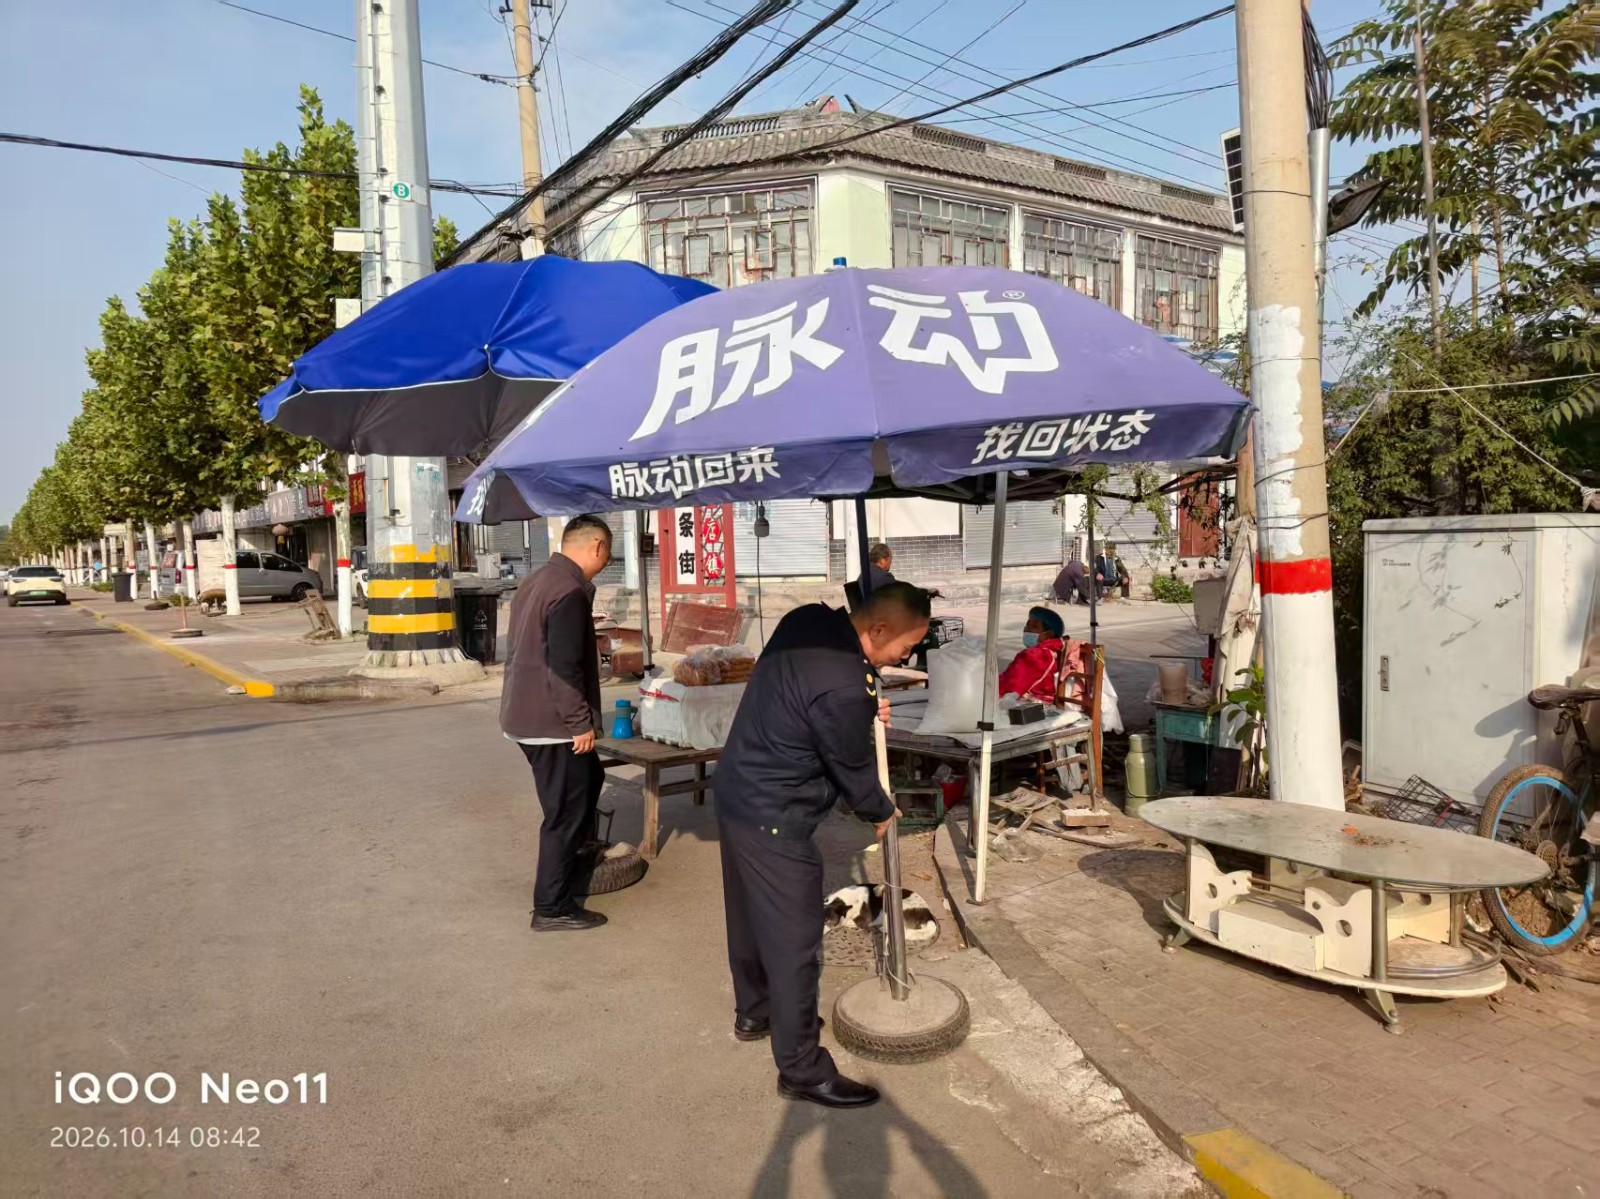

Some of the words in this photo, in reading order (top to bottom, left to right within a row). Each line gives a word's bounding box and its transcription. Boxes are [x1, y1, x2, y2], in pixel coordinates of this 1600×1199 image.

[971, 409, 1156, 465] 找回状态
[608, 446, 781, 500] 脉动回来
[678, 512, 695, 575] 条街
